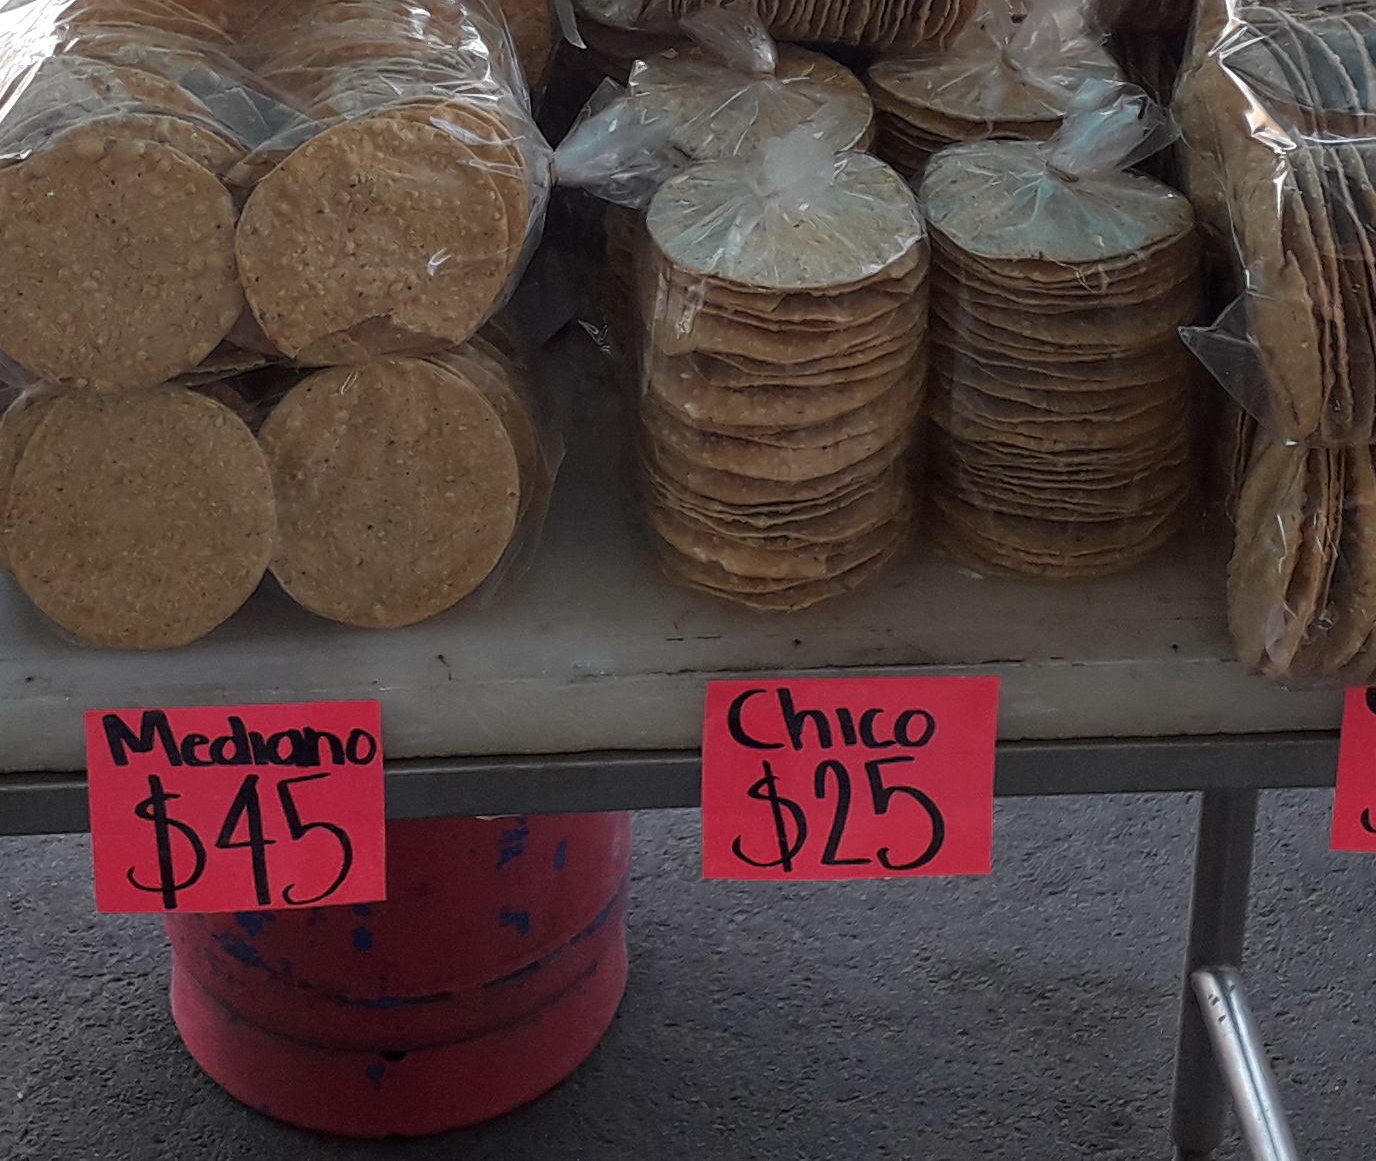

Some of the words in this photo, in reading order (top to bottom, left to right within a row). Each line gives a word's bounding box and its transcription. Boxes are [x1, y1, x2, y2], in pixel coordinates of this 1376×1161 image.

[102, 709, 379, 768] Mediano
[727, 687, 937, 751] Chico
[125, 771, 356, 911] $45
[731, 755, 946, 873] $25
